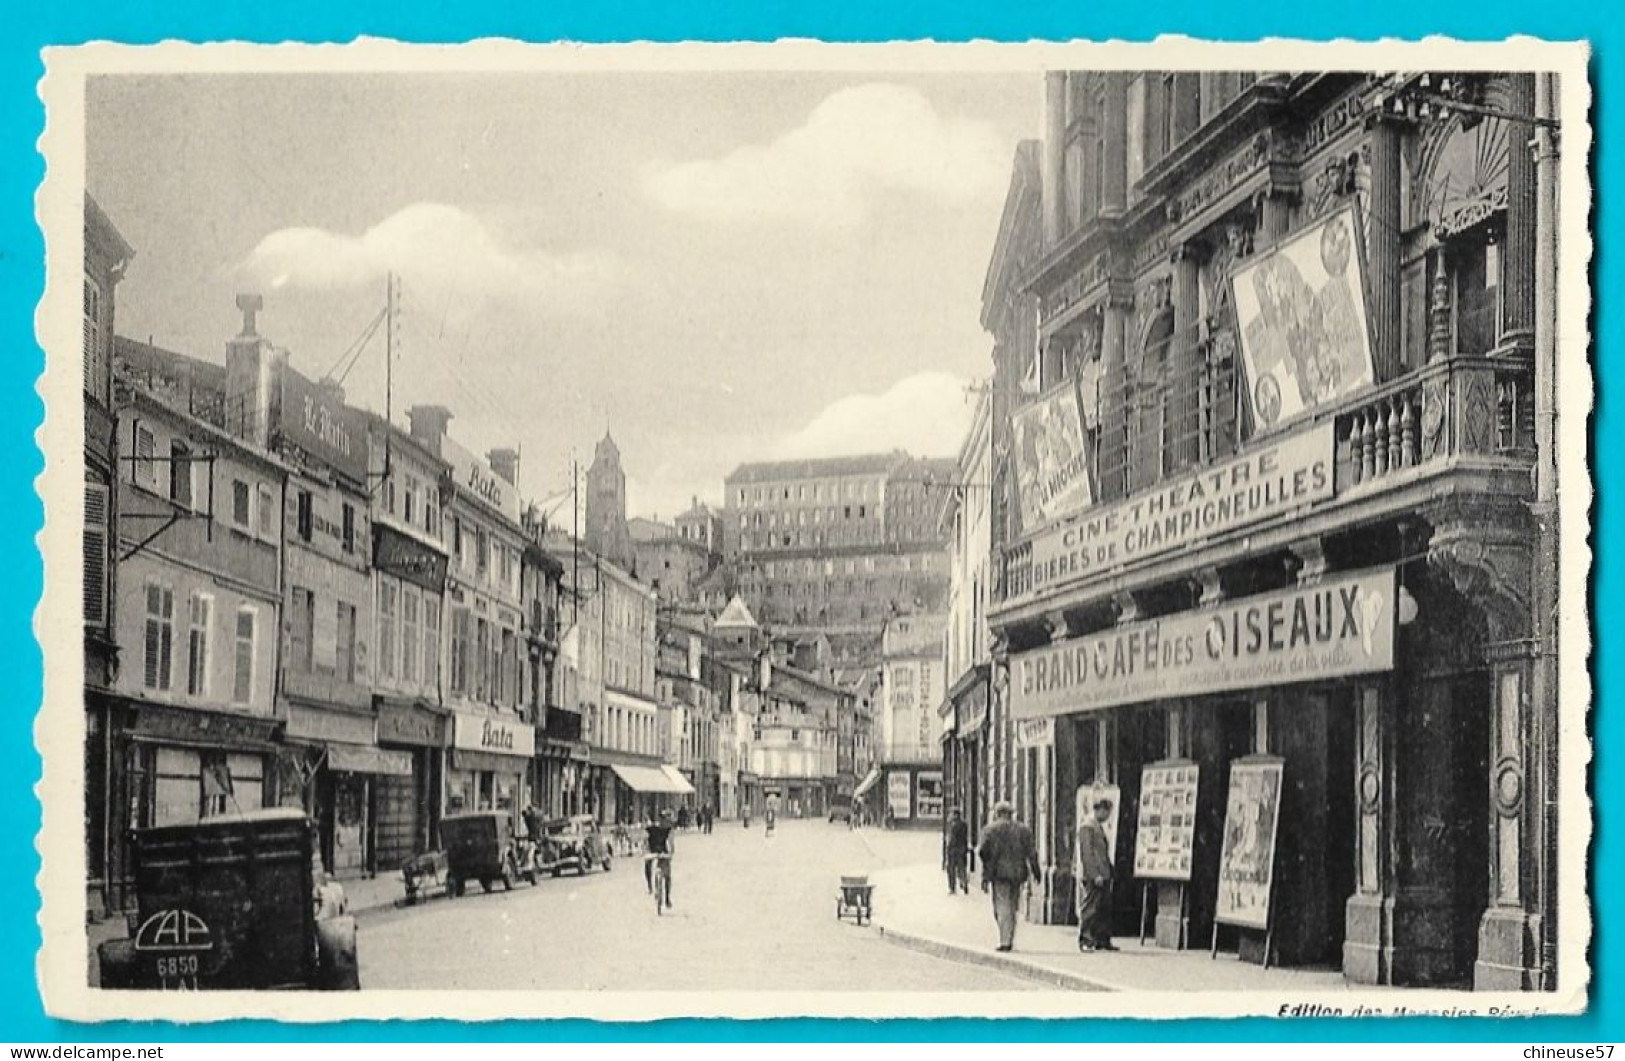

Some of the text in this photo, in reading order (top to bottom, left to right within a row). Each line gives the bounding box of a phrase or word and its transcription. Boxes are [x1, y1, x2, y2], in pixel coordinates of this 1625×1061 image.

[468, 462, 501, 507] Bata
[1097, 542, 1117, 563] DE
[1125, 460, 1327, 553] CHAMPIGNEULLES
[1022, 644, 1089, 696] GRAND
[1162, 636, 1194, 668] DES
[1205, 583, 1360, 661] OISEAUX
[481, 720, 513, 749] Bata
